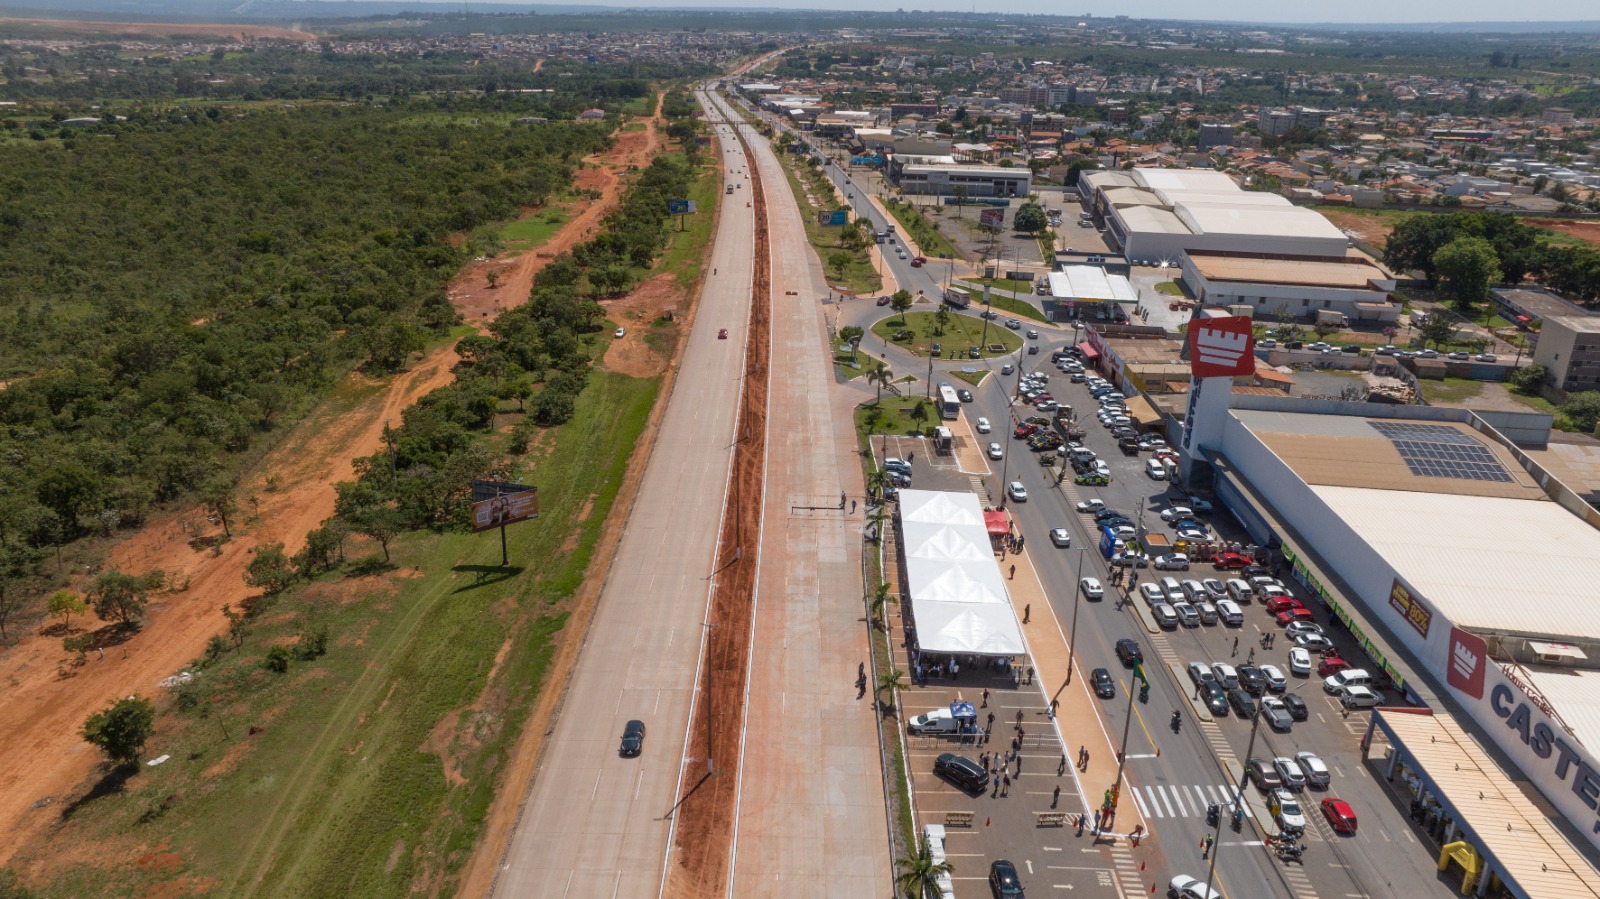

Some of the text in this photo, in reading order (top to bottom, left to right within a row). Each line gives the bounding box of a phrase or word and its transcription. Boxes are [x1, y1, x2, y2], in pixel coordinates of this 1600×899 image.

[1410, 605, 1428, 630] 80%
[1502, 664, 1554, 718] Home Center
[1491, 684, 1600, 816] CASTE
[1095, 871, 1112, 886] PARE
